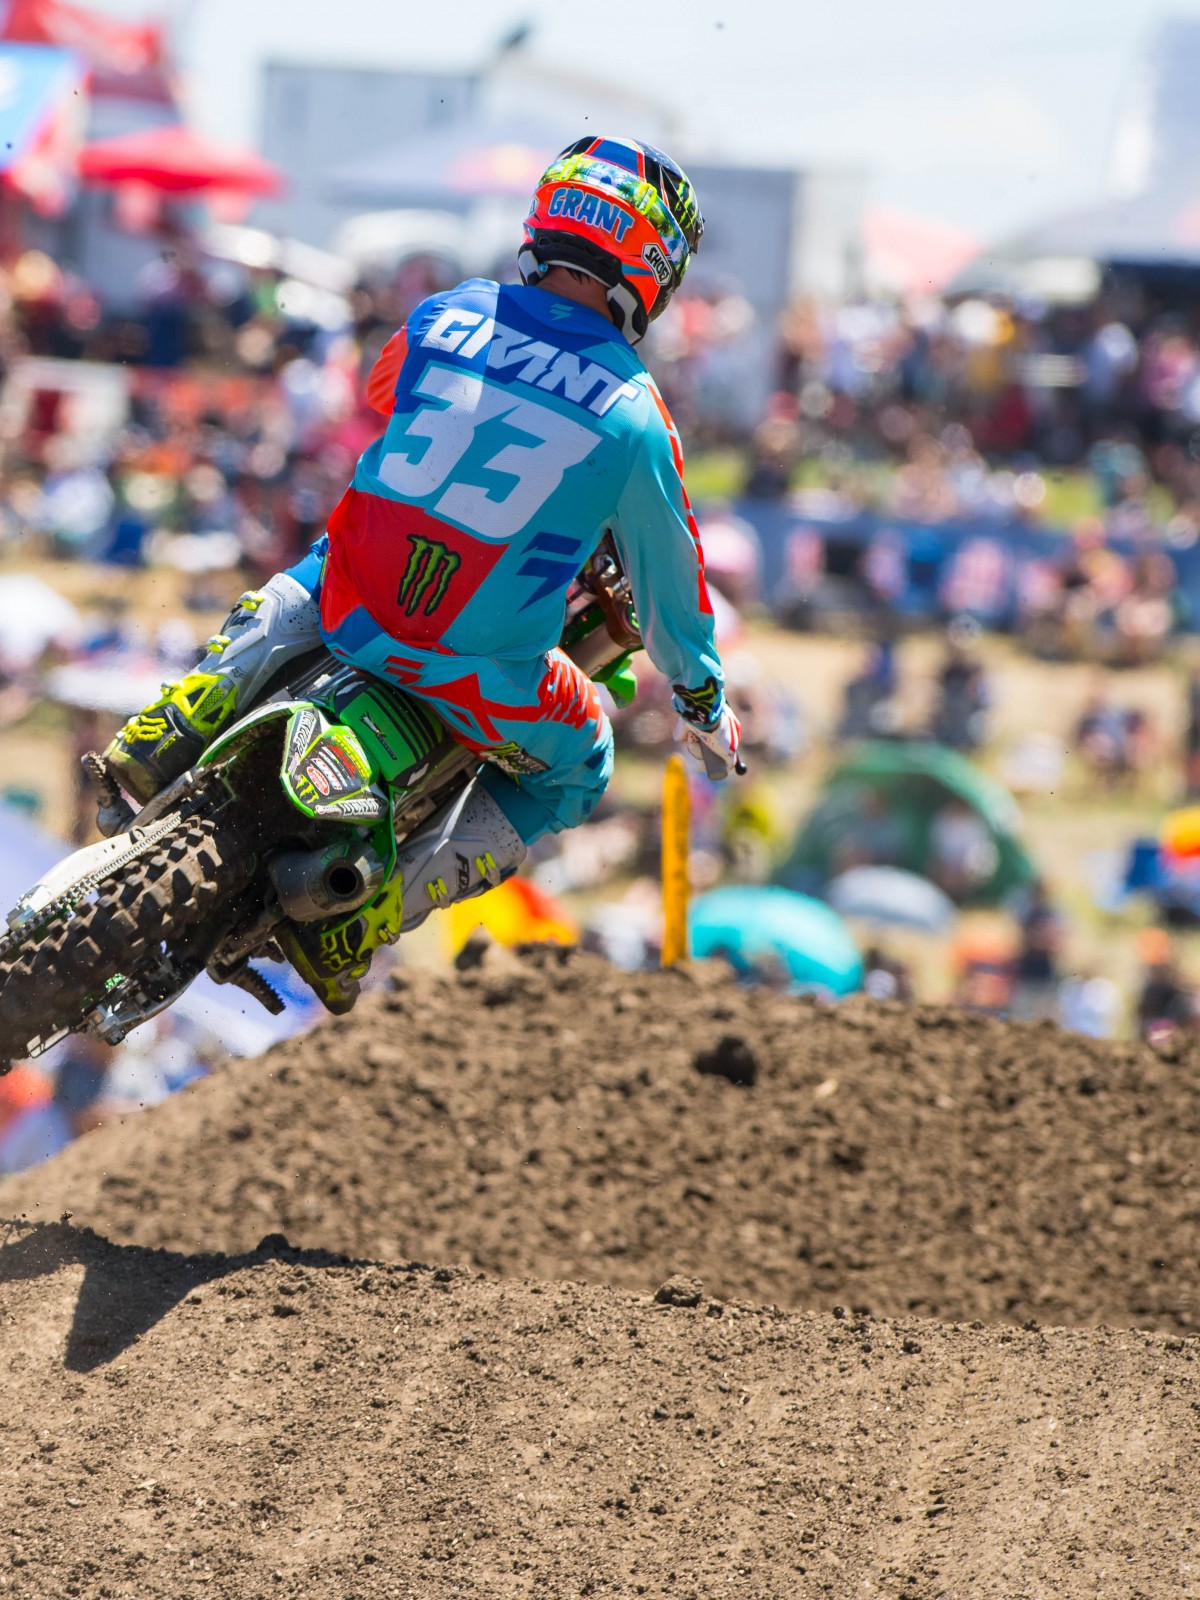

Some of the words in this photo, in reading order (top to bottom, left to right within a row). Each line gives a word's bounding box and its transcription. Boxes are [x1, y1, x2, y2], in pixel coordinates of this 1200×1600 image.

[548, 187, 635, 243] GRANT
[420, 308, 641, 416] GRANT
[378, 366, 603, 538] 33
